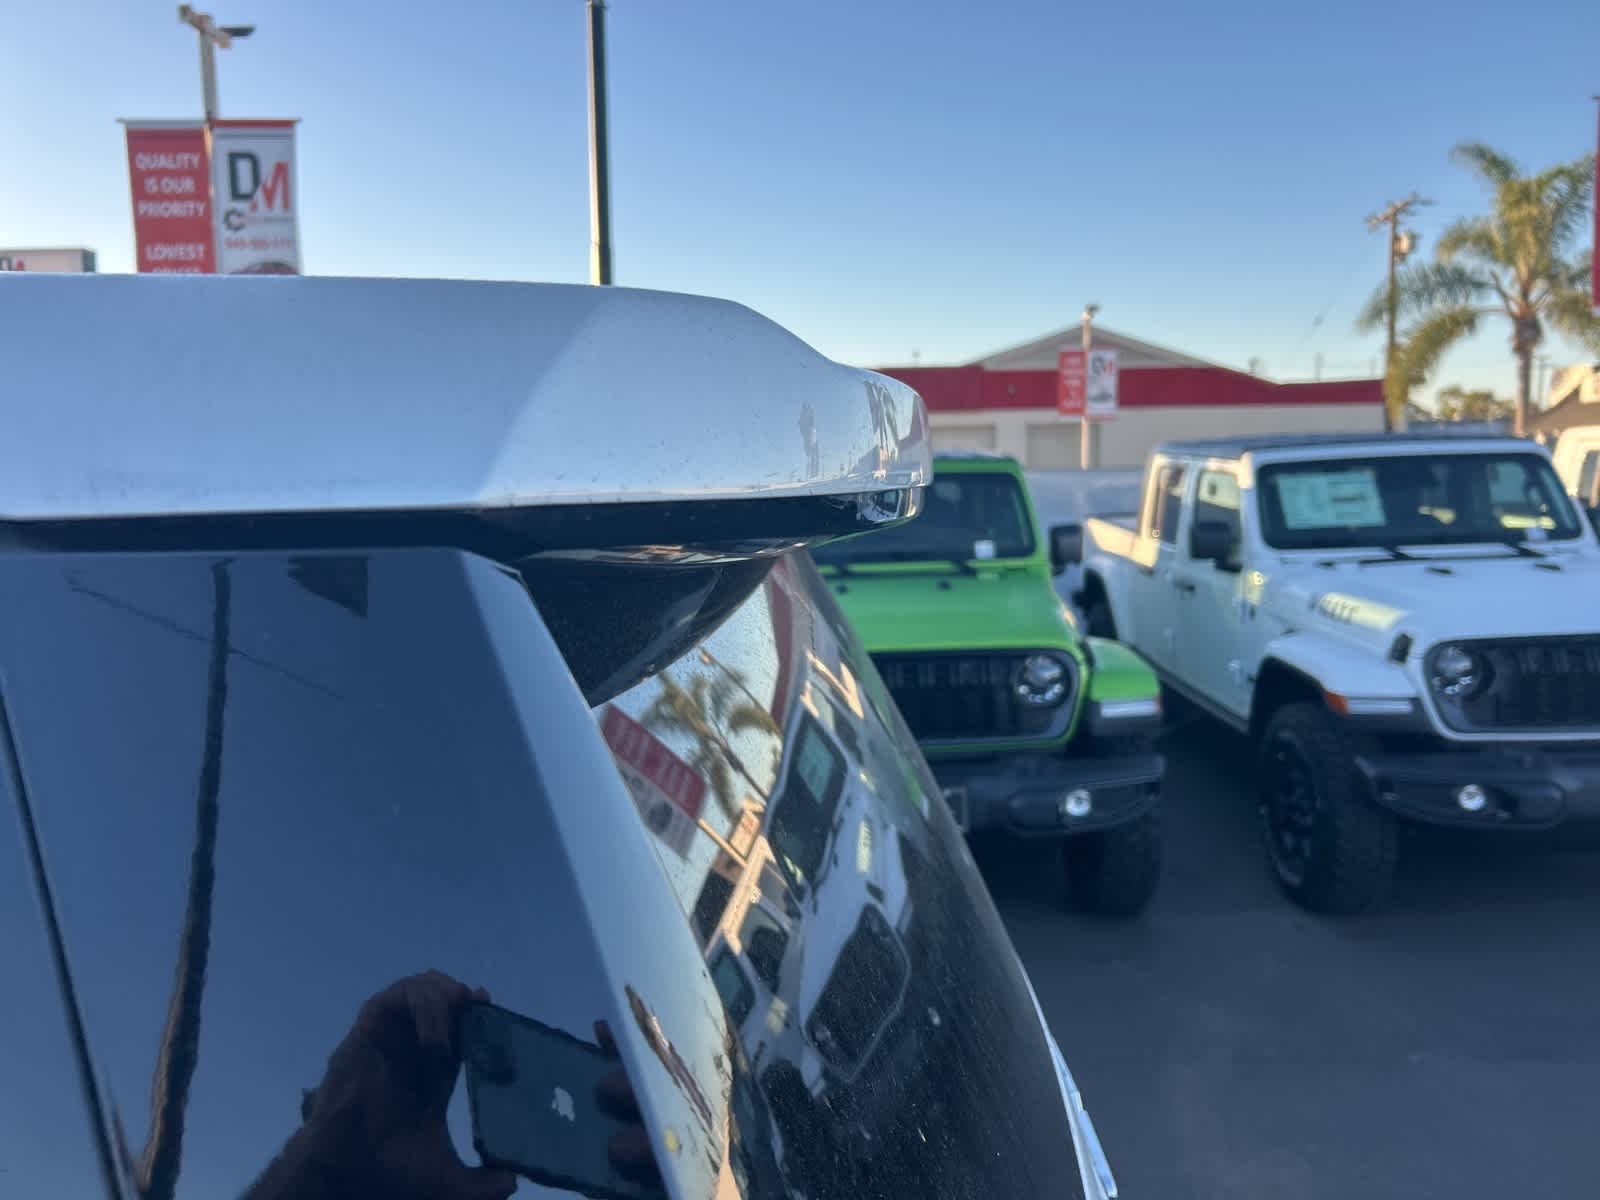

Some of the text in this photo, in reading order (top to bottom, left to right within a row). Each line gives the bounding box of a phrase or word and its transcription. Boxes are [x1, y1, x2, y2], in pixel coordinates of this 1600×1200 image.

[135, 152, 200, 170] QUALITY
[144, 176, 195, 193] IS OUR
[138, 200, 206, 218] PRIORITY
[146, 243, 205, 261] LOWEST
